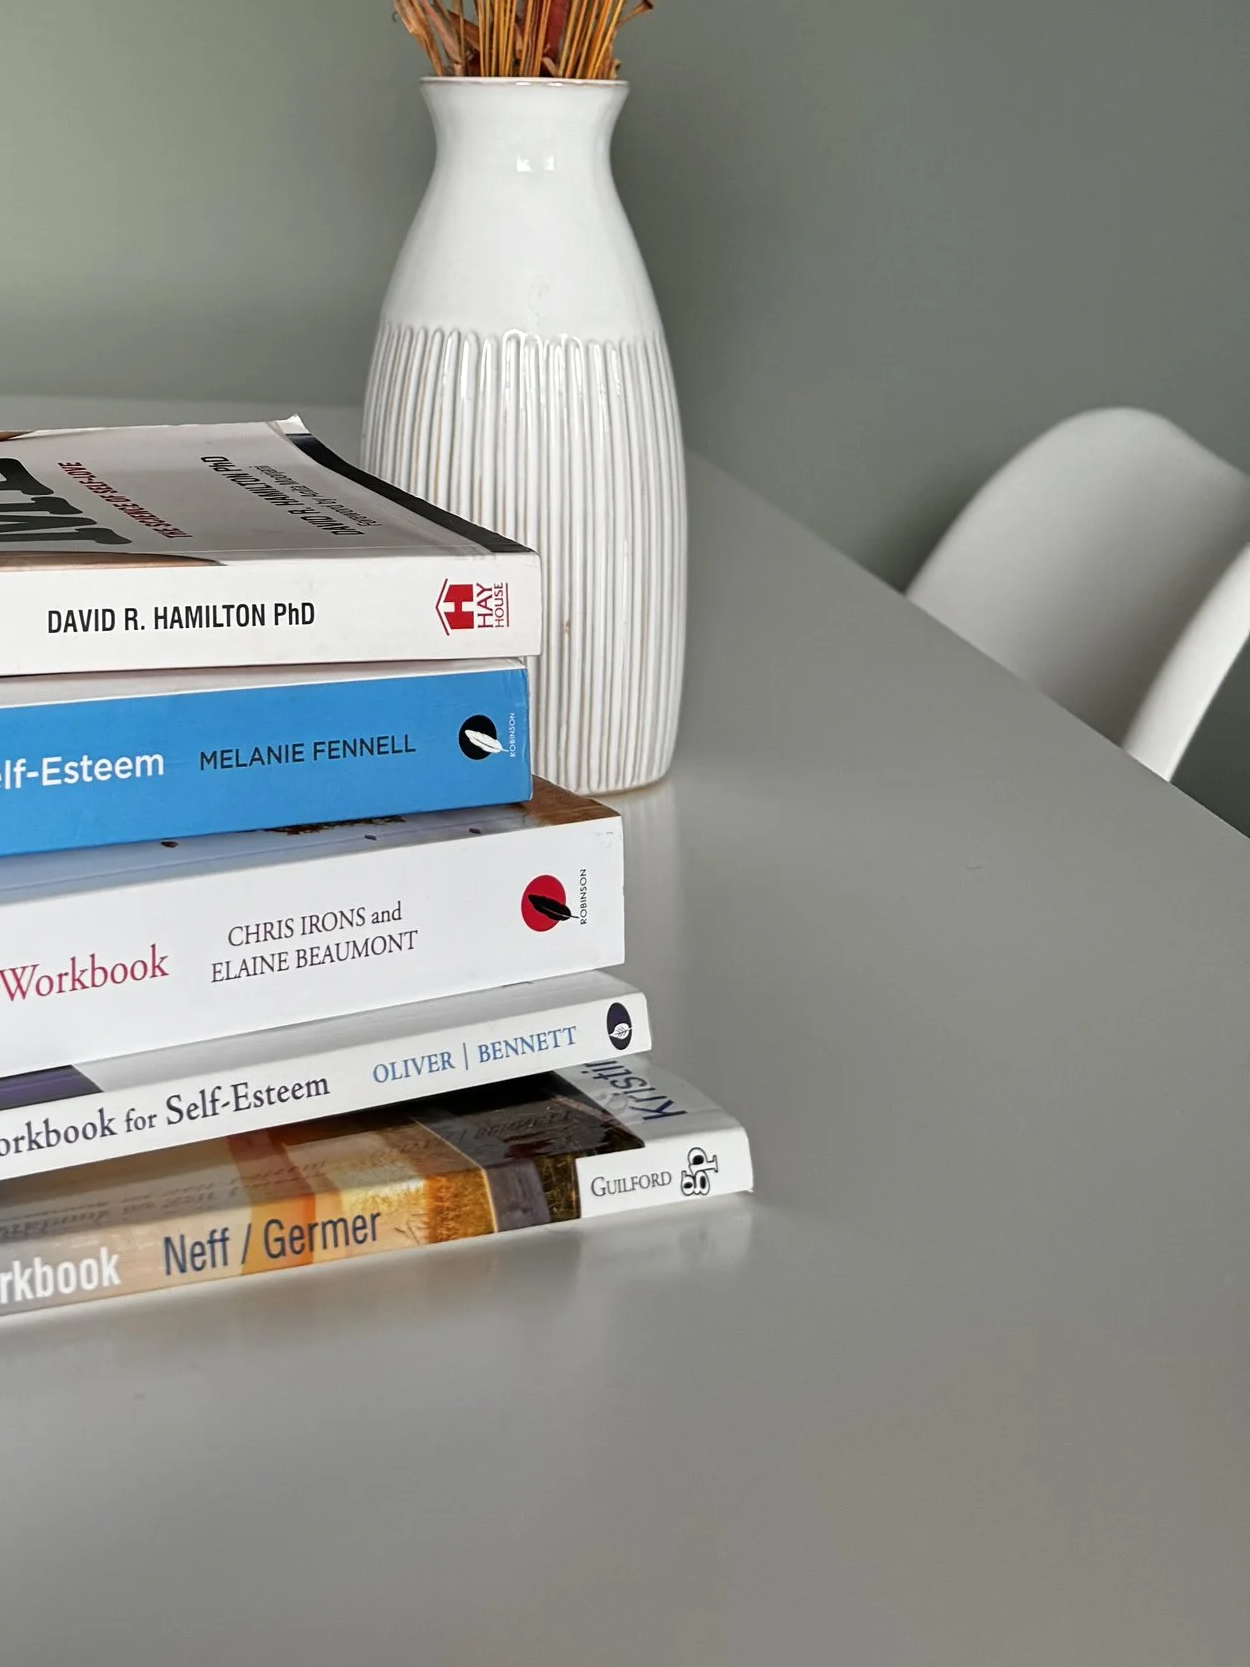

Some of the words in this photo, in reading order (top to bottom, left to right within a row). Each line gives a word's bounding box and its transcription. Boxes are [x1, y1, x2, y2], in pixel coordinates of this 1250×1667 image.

[200, 456, 242, 473] PhD
[222, 472, 305, 506] HAMILTON
[300, 515, 366, 536] DAVID
[48, 607, 116, 634] DAVID
[124, 607, 146, 632] R.
[153, 603, 264, 630] HAMILTON
[273, 601, 315, 627] PhD
[476, 582, 494, 629] HAY
[493, 581, 505, 628] HOUSE
[199, 741, 307, 772] MELANIE
[312, 733, 417, 761] FENNELL
[508, 712, 517, 758] ROBINSON
[579, 868, 588, 925] ROBINSON
[227, 915, 296, 949] CHRIS
[299, 906, 368, 941] IRONS
[371, 901, 403, 928] and
[210, 951, 291, 984] ELAINE
[295, 930, 419, 974] BEAUMONT
[372, 1048, 456, 1084] OLIVER
[477, 1025, 577, 1064] BENNETT
[124, 1105, 159, 1134] for
[165, 1072, 330, 1125] Self-Esteem
[591, 1171, 672, 1197] GUILFORD
[163, 1229, 230, 1276] Neff
[263, 1209, 381, 1259] Germer
